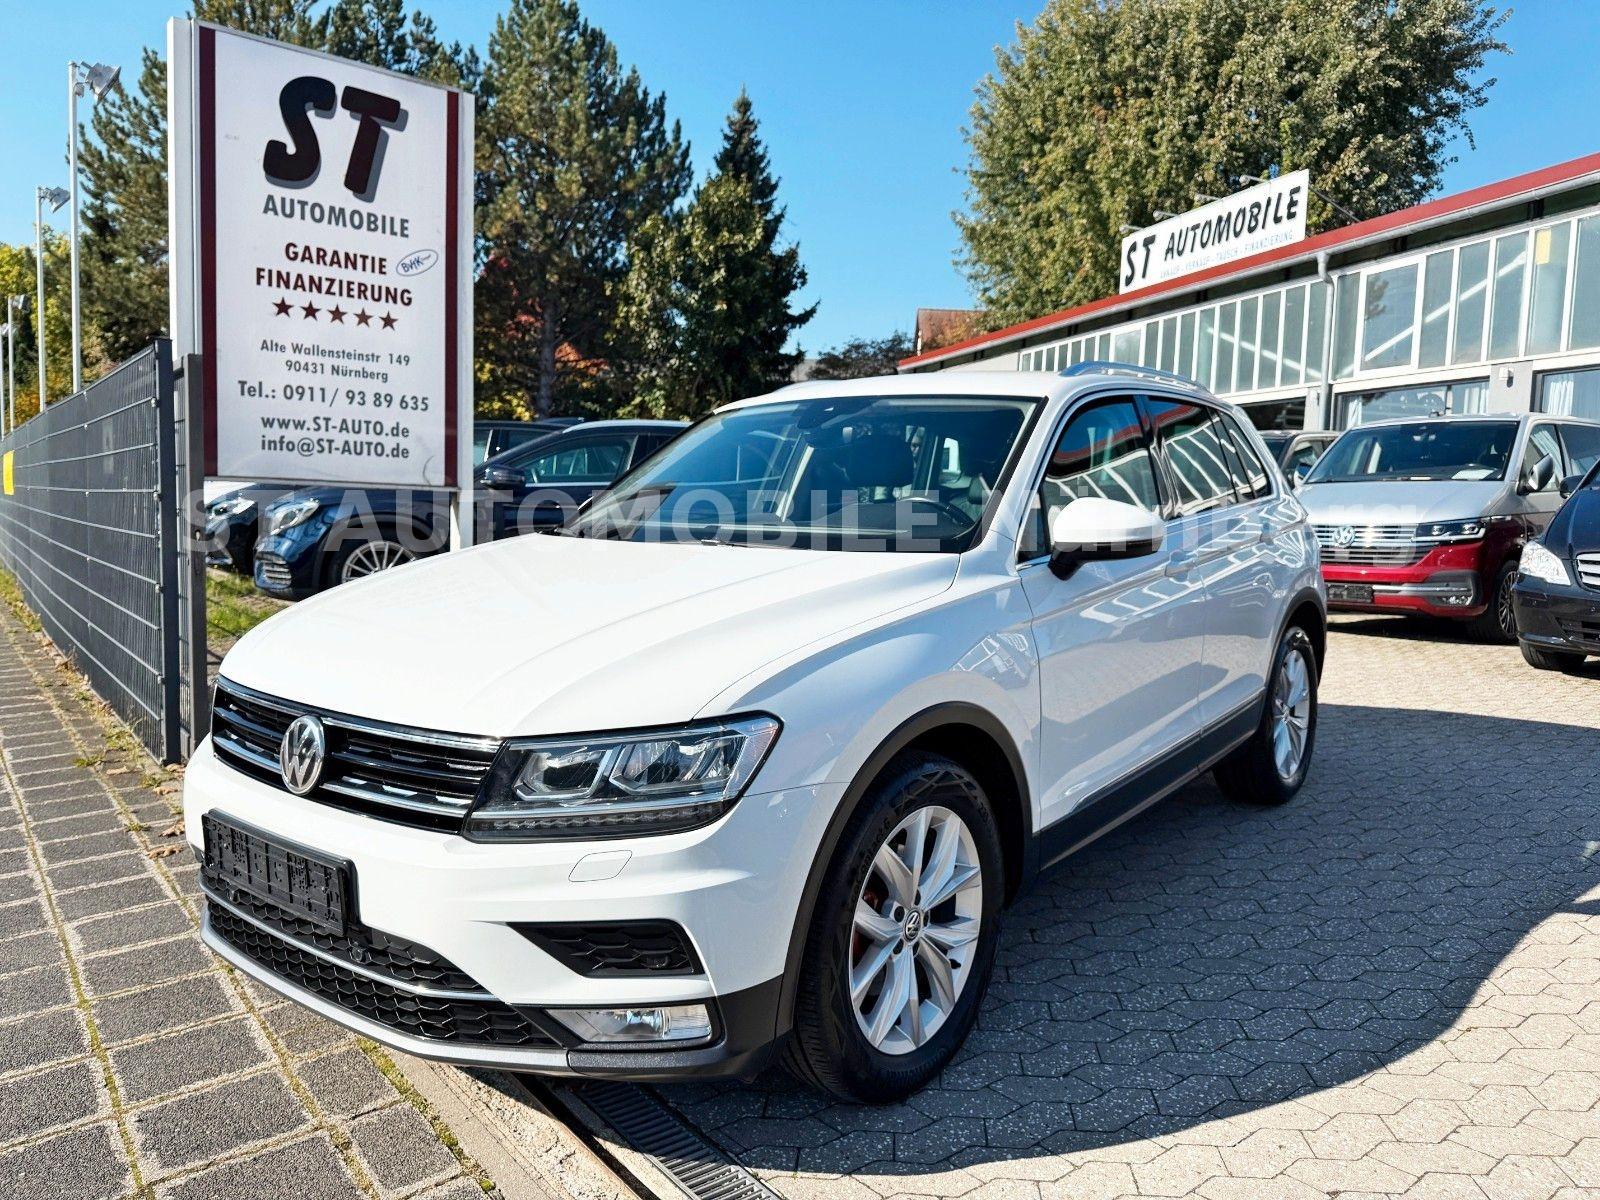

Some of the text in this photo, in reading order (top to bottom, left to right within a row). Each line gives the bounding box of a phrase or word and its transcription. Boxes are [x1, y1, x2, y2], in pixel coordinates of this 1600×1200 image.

[263, 76, 408, 202] ST
[262, 194, 410, 239] AUTOMOBILE
[1125, 185, 1301, 287] ST AUTOMOBILE
[285, 242, 387, 275] GARANTIE
[256, 267, 413, 307] FINANZIERUNG
[260, 339, 410, 366] Alte Wallensteinstr 149
[285, 359, 389, 383] 90431 Nürnberg
[238, 380, 429, 412] Tel.: 0911/ 93 89 635
[261, 416, 410, 438] www.ST-AUTO.de
[261, 435, 410, 459] info@ST-AUTO.de
